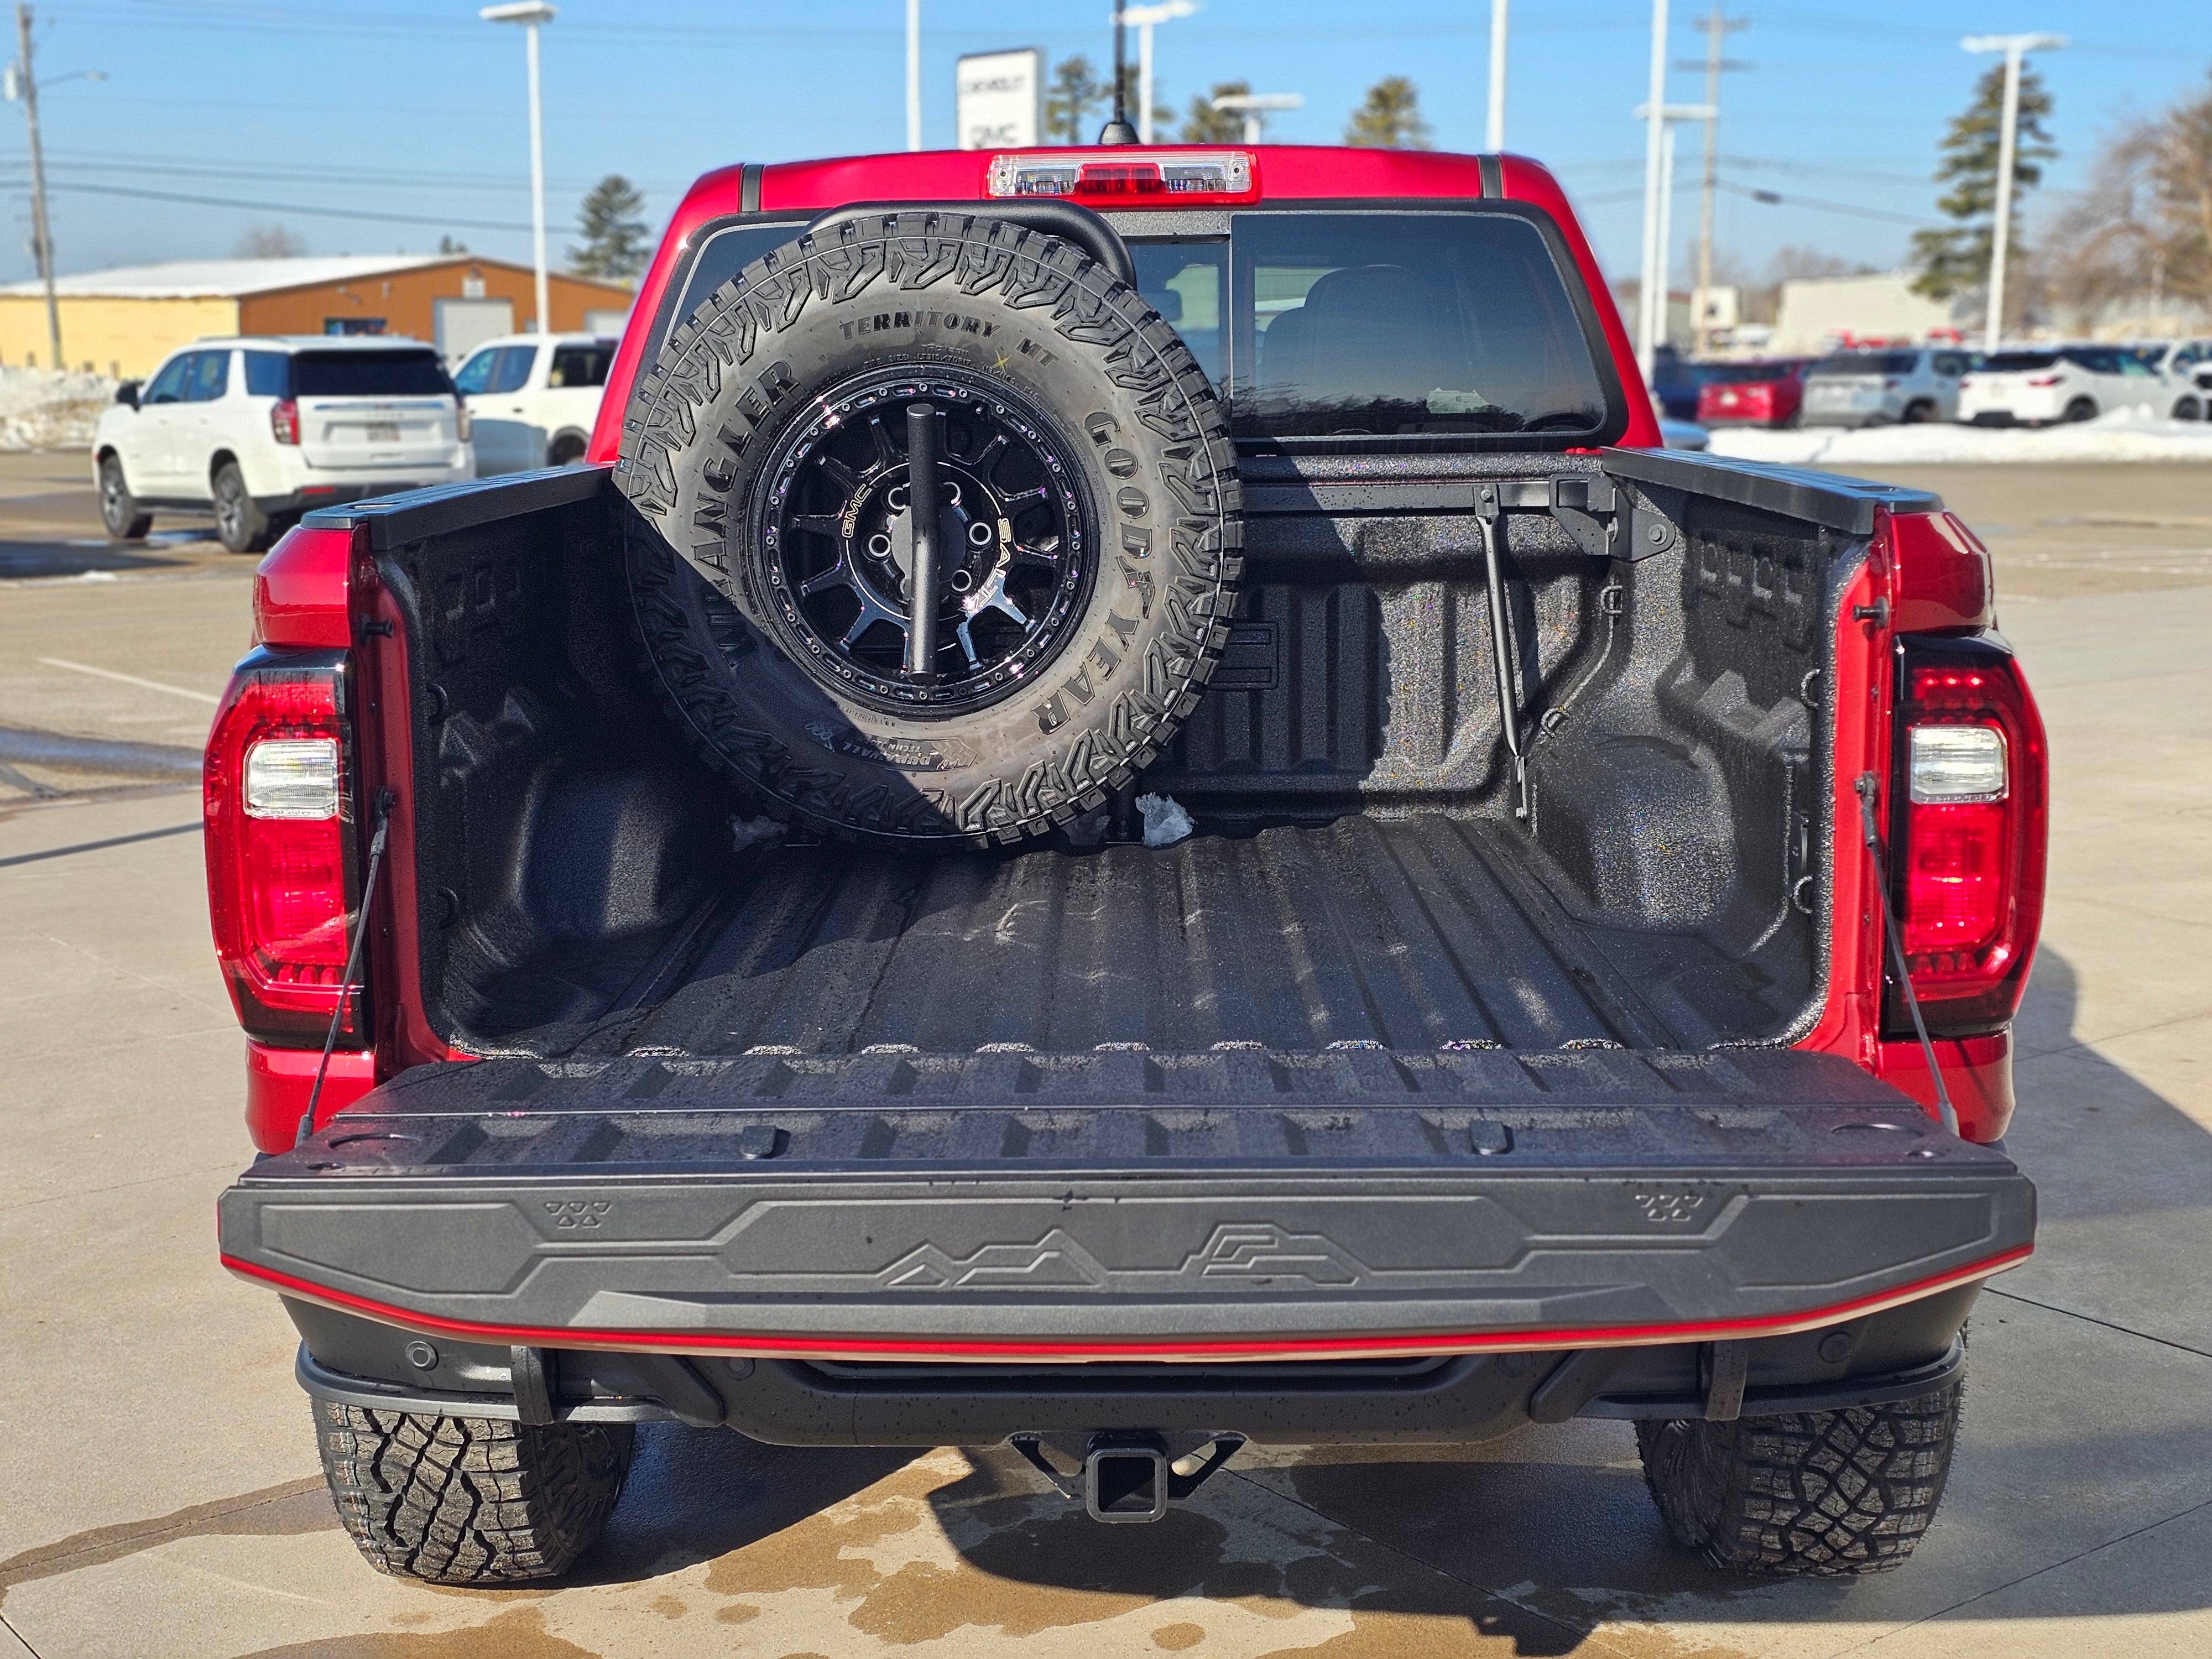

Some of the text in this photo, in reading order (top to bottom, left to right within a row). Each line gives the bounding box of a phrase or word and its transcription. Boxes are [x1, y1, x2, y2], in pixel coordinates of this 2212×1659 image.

[839, 310, 1058, 367] TERRITORY MT
[692, 360, 801, 668] WRANGLER
[842, 483, 873, 539] GMC
